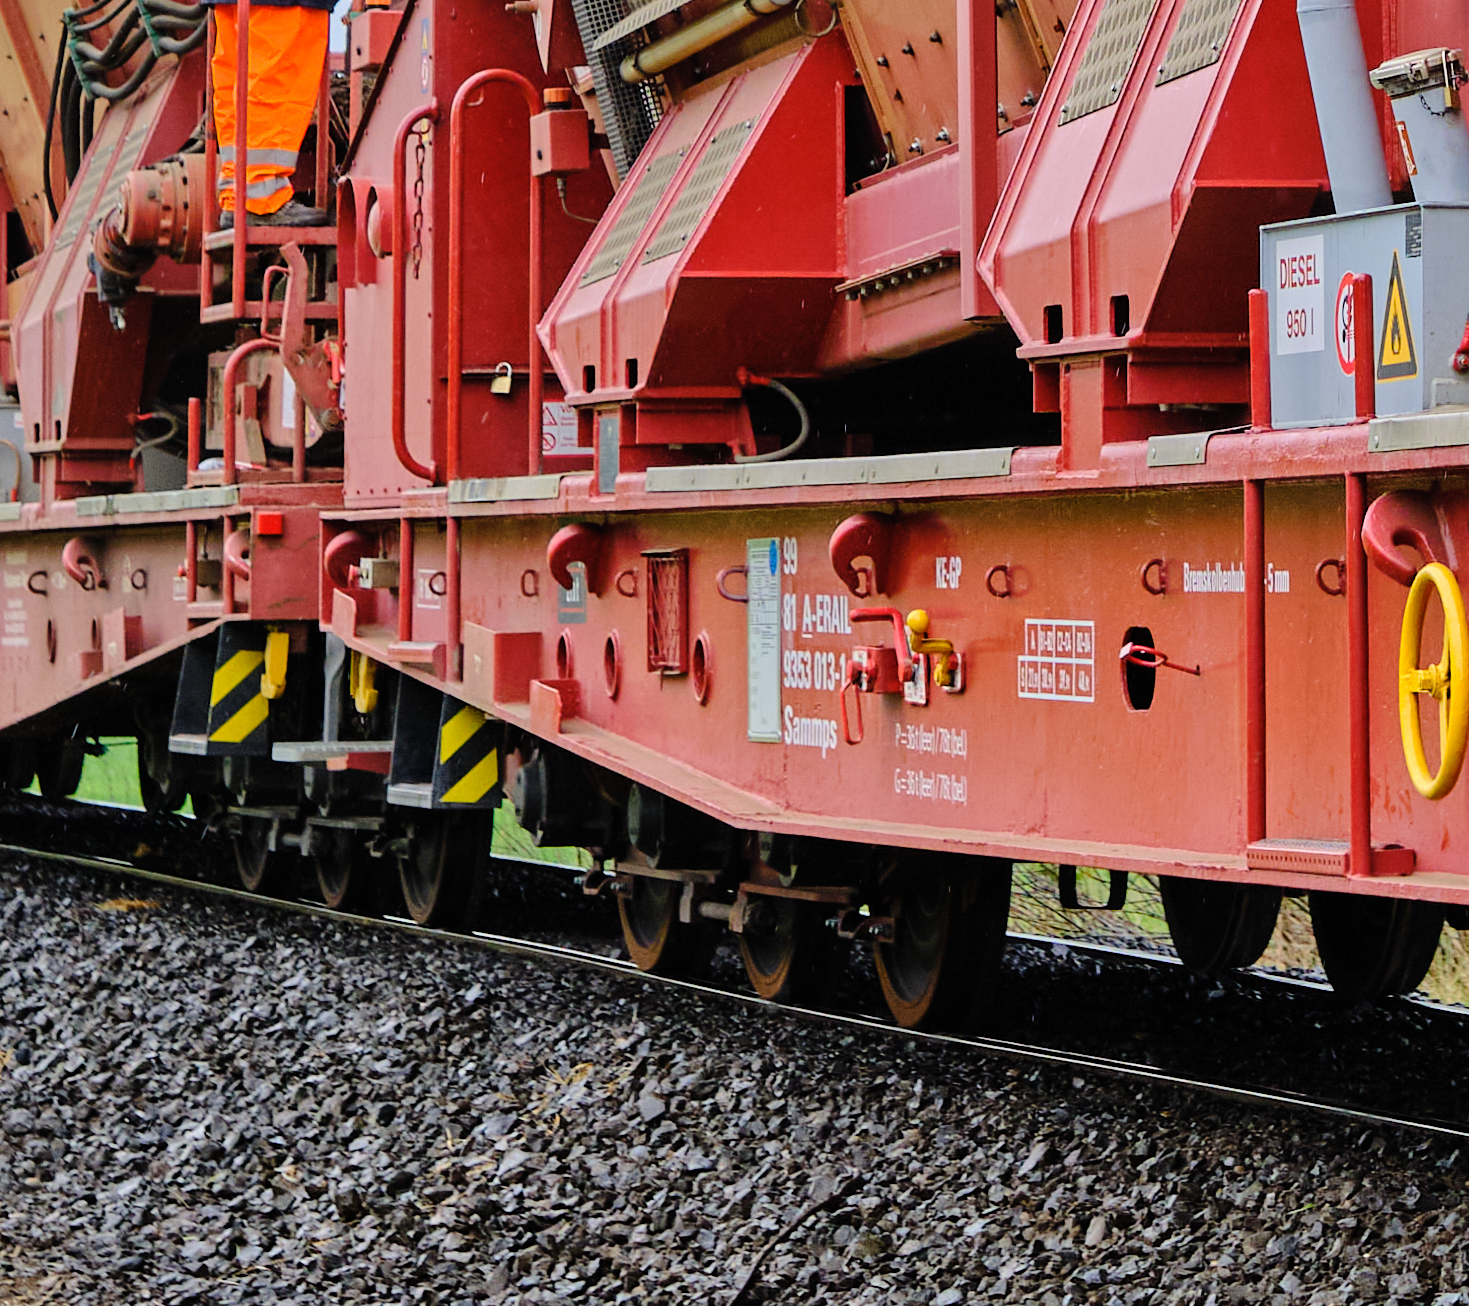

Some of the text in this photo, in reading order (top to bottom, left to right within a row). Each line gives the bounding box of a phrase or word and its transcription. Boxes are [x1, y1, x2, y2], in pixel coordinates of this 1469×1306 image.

[1280, 254, 1320, 290] DIESEL
[1286, 309, 1307, 339] 950
[783, 536, 798, 576] 99
[935, 556, 963, 589] KE-GP
[1182, 561, 1245, 593] Bremskolbenhub
[783, 592, 852, 637] 81 A-ERAIL
[783, 649, 846, 691] 9353 013-1
[783, 704, 838, 759] Sammps
